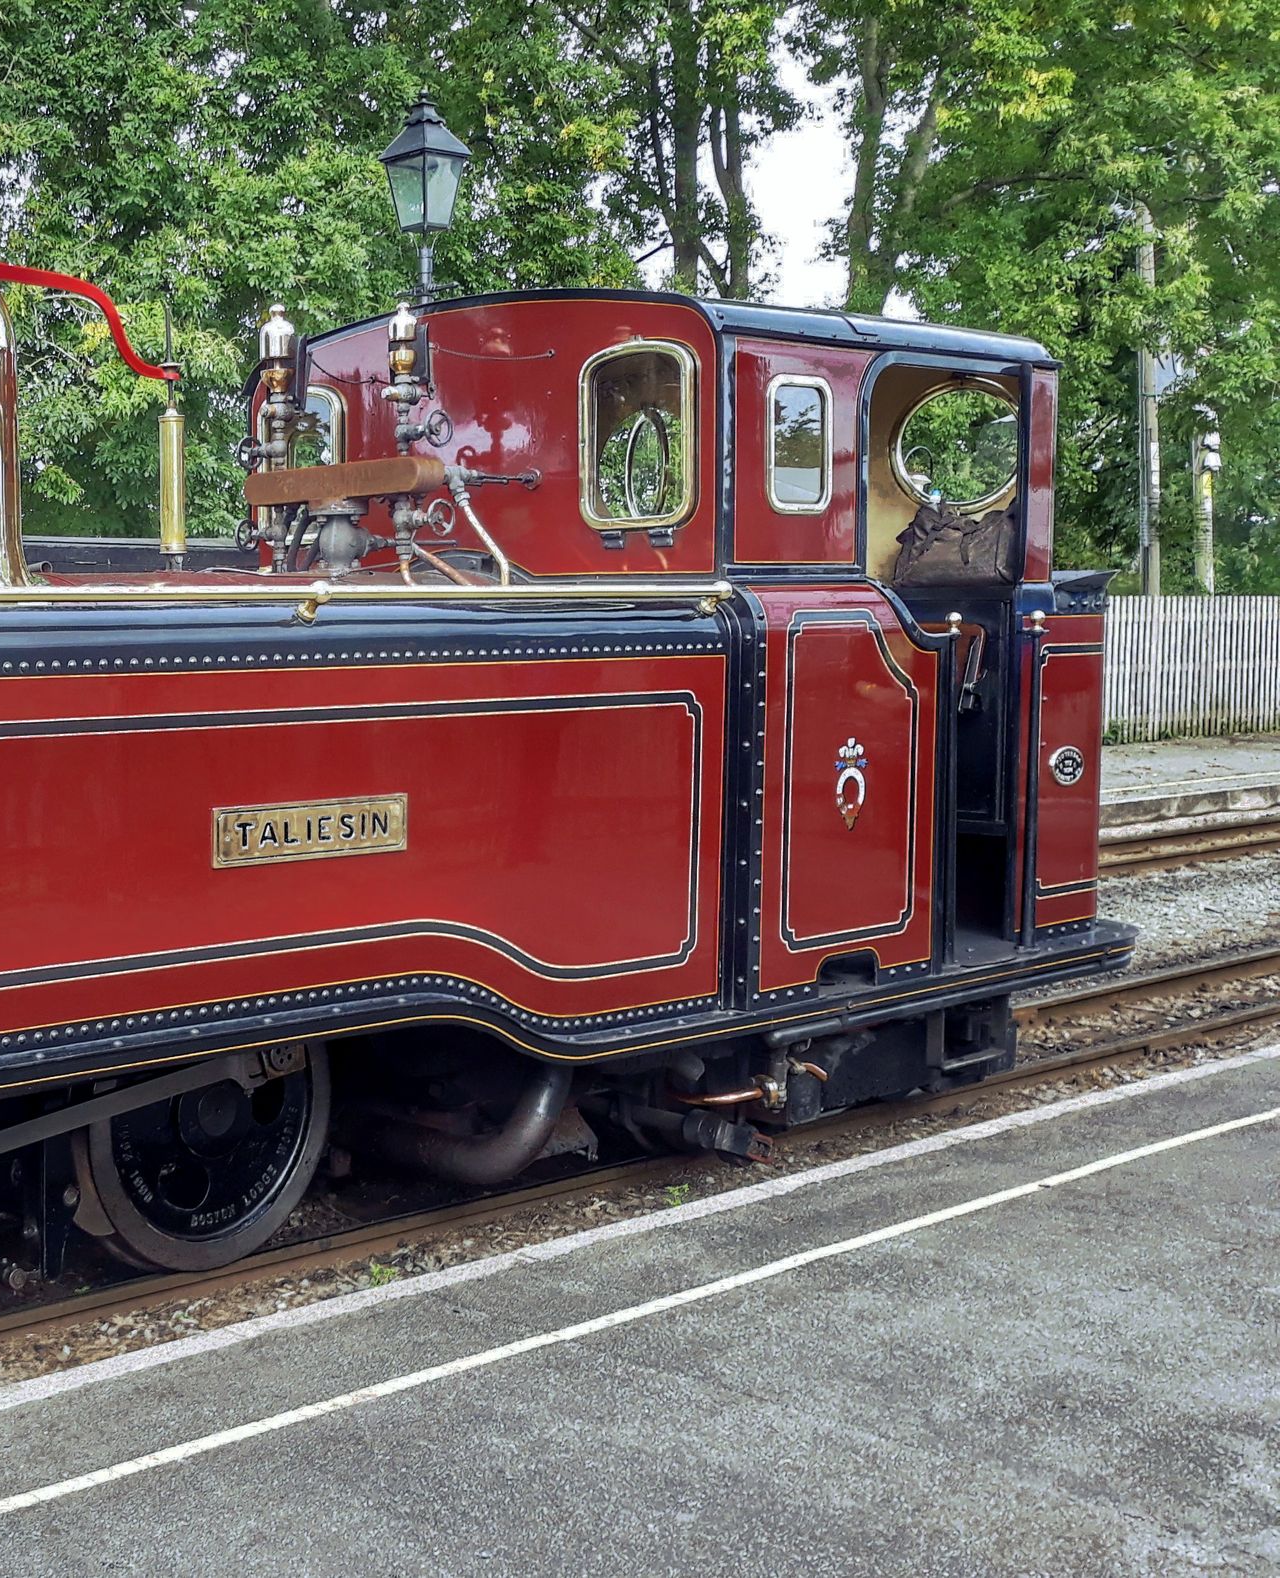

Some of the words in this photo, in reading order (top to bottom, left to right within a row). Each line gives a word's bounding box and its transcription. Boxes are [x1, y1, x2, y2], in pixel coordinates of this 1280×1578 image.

[234, 811, 390, 850] TALIESIN
[190, 1202, 237, 1228] BOSTON
[243, 1163, 278, 1206] LODGE
